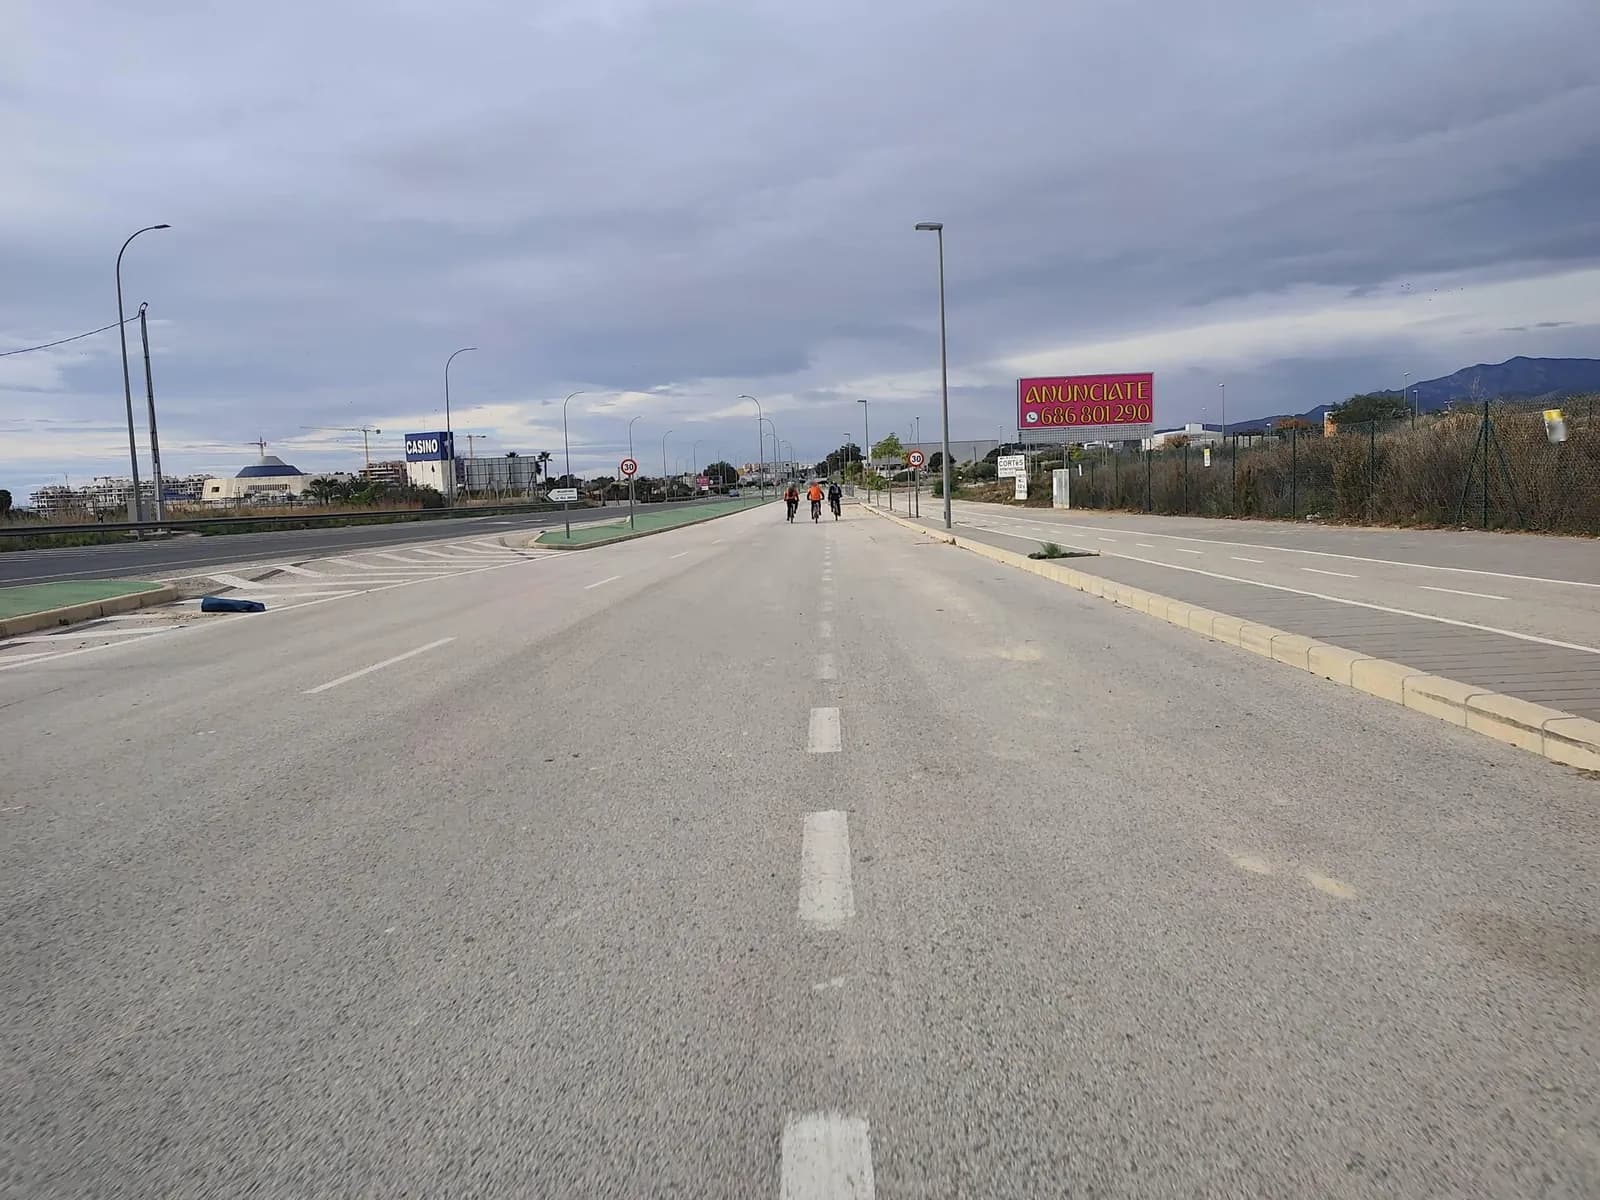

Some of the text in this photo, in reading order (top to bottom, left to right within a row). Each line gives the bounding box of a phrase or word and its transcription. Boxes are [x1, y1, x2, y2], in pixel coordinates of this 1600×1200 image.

[1025, 380, 1149, 404] ANÚNCIATE
[1040, 403, 1150, 425] 686 801 290
[407, 440, 438, 454] CASINO
[912, 455, 922, 463] 30
